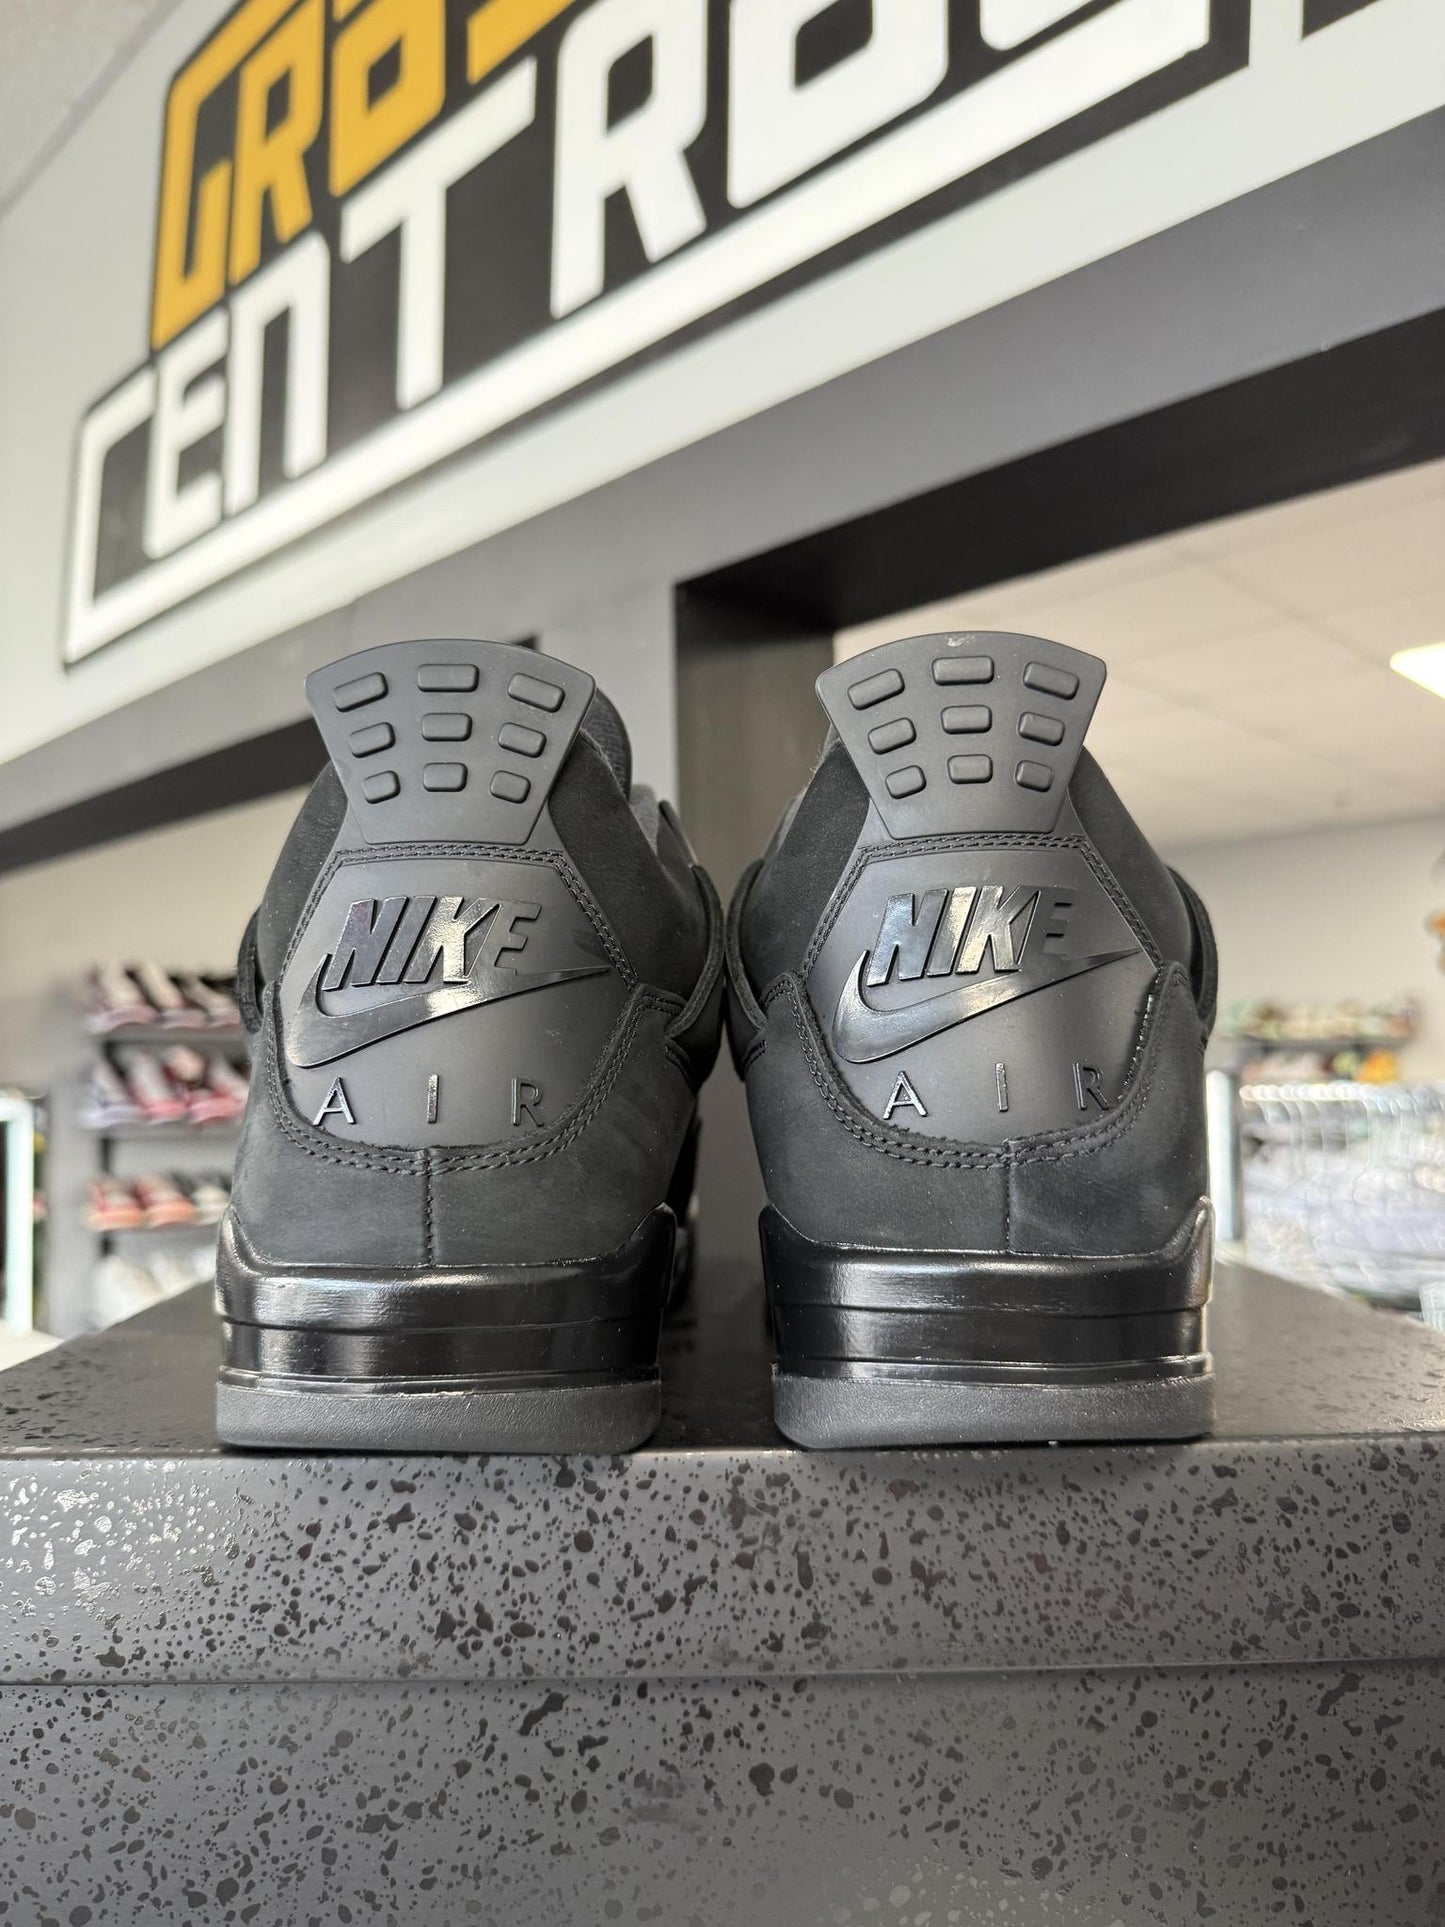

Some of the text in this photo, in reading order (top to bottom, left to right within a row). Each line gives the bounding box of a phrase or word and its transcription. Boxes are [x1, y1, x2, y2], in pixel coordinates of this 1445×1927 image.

[321, 895, 543, 991] NIKE
[867, 885, 1077, 987] NIKE
[312, 1073, 545, 1126] AIR
[882, 1061, 1109, 1121] AIR
